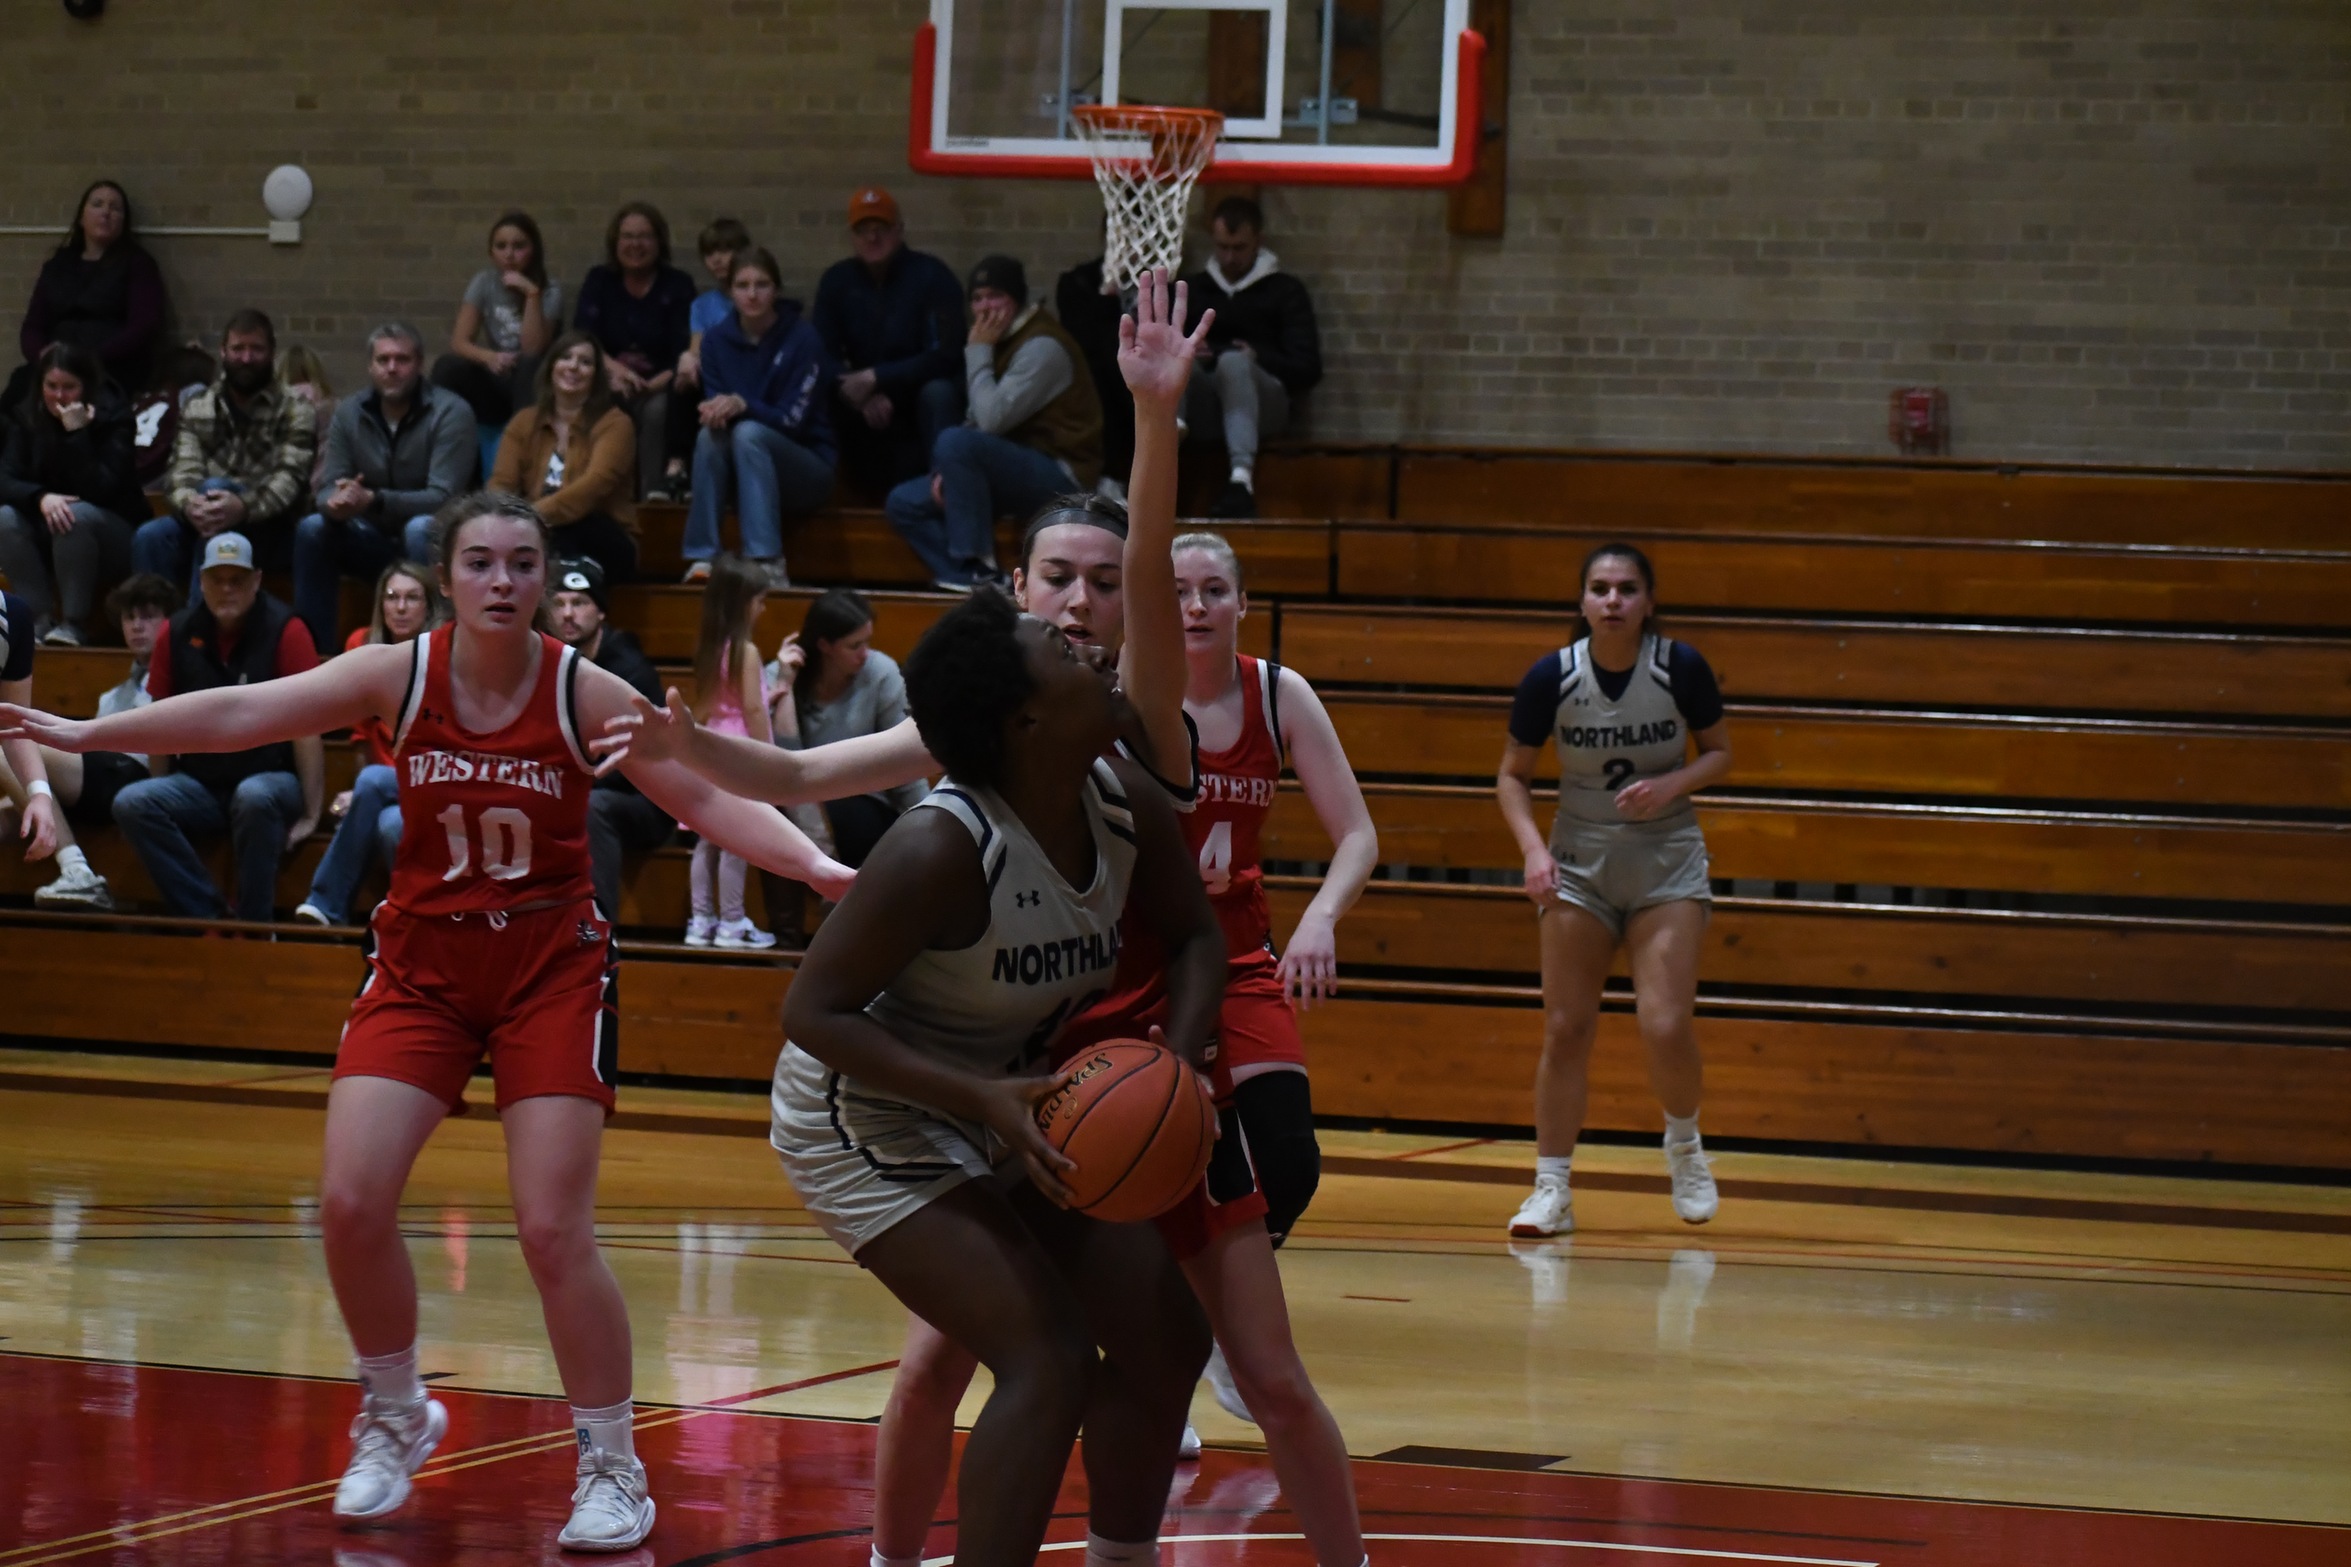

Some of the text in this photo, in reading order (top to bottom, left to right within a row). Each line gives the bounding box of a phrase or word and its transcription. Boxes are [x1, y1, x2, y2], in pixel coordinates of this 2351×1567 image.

[1561, 719, 1677, 748] NORTHLAND
[407, 750, 565, 799] WESTERN
[1195, 774, 1278, 807] STERN
[1603, 758, 1635, 791] 2
[436, 803, 532, 881] 10
[1199, 820, 1232, 895] 4
[1037, 1052, 1113, 1130] SPALDIN
